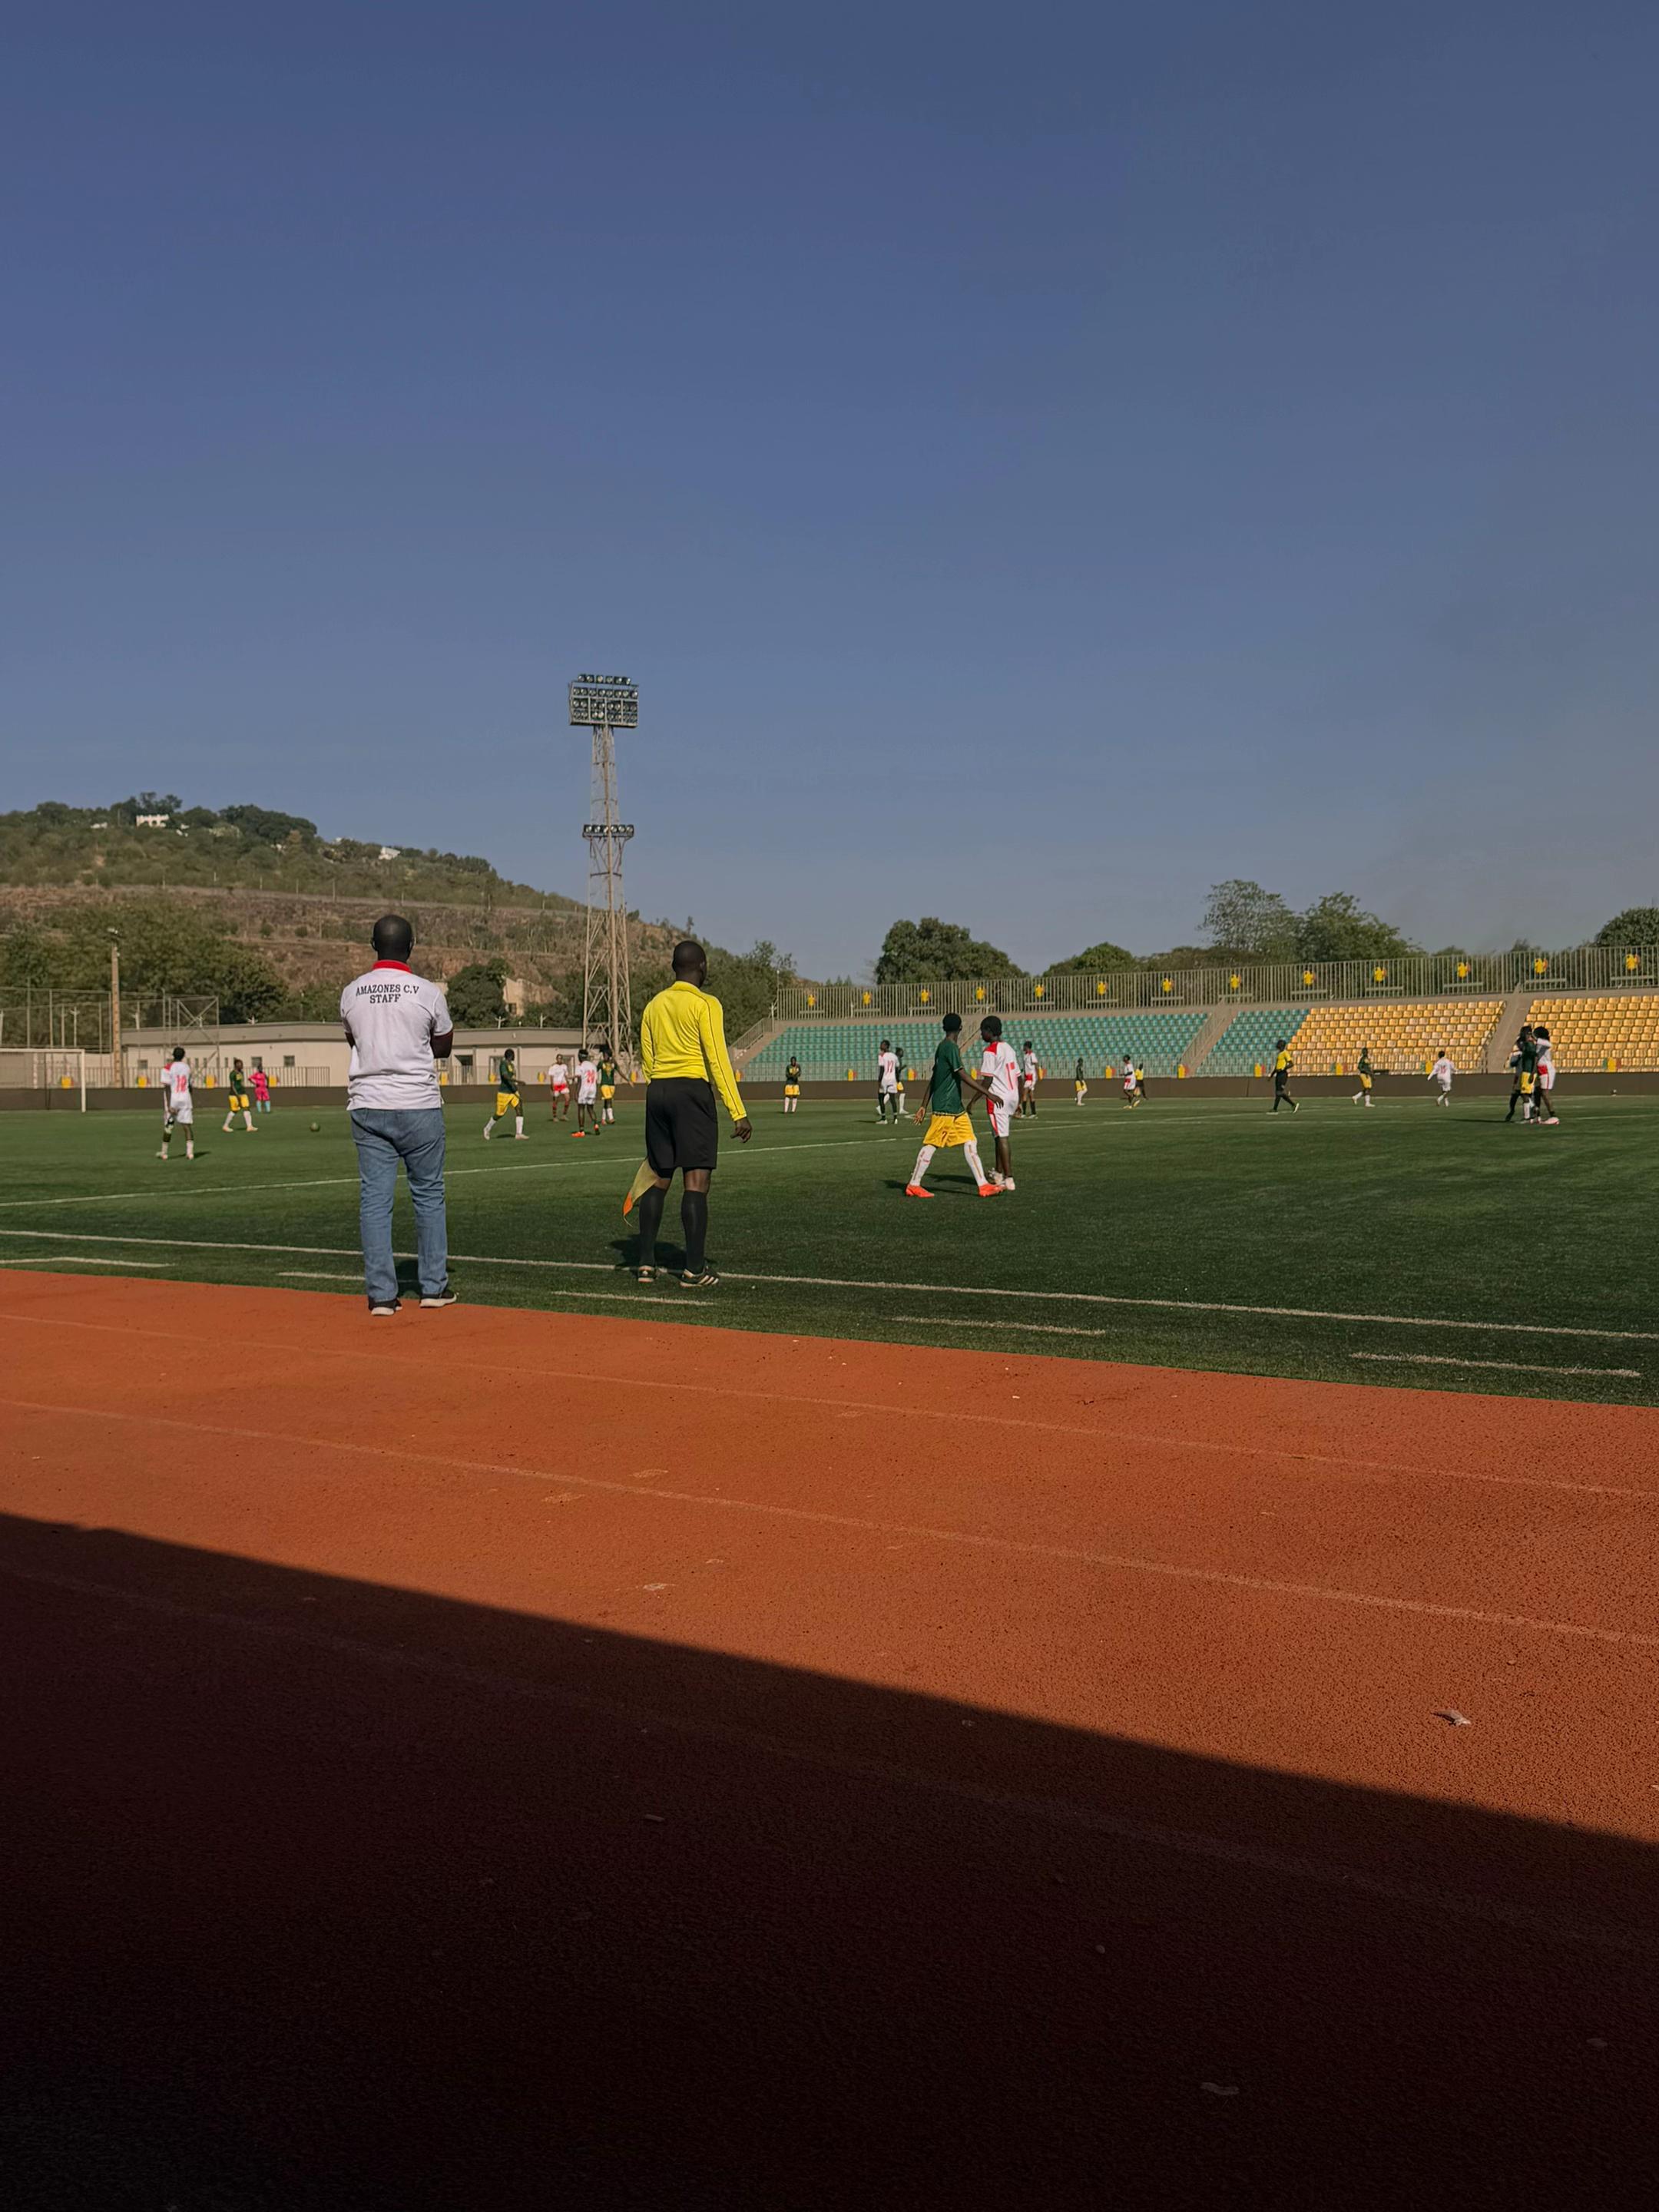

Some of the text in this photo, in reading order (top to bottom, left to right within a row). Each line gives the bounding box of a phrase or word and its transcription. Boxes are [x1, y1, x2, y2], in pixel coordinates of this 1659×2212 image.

[356, 984, 419, 996] AMAZONES C.V
[369, 994, 401, 1004] STAFF
